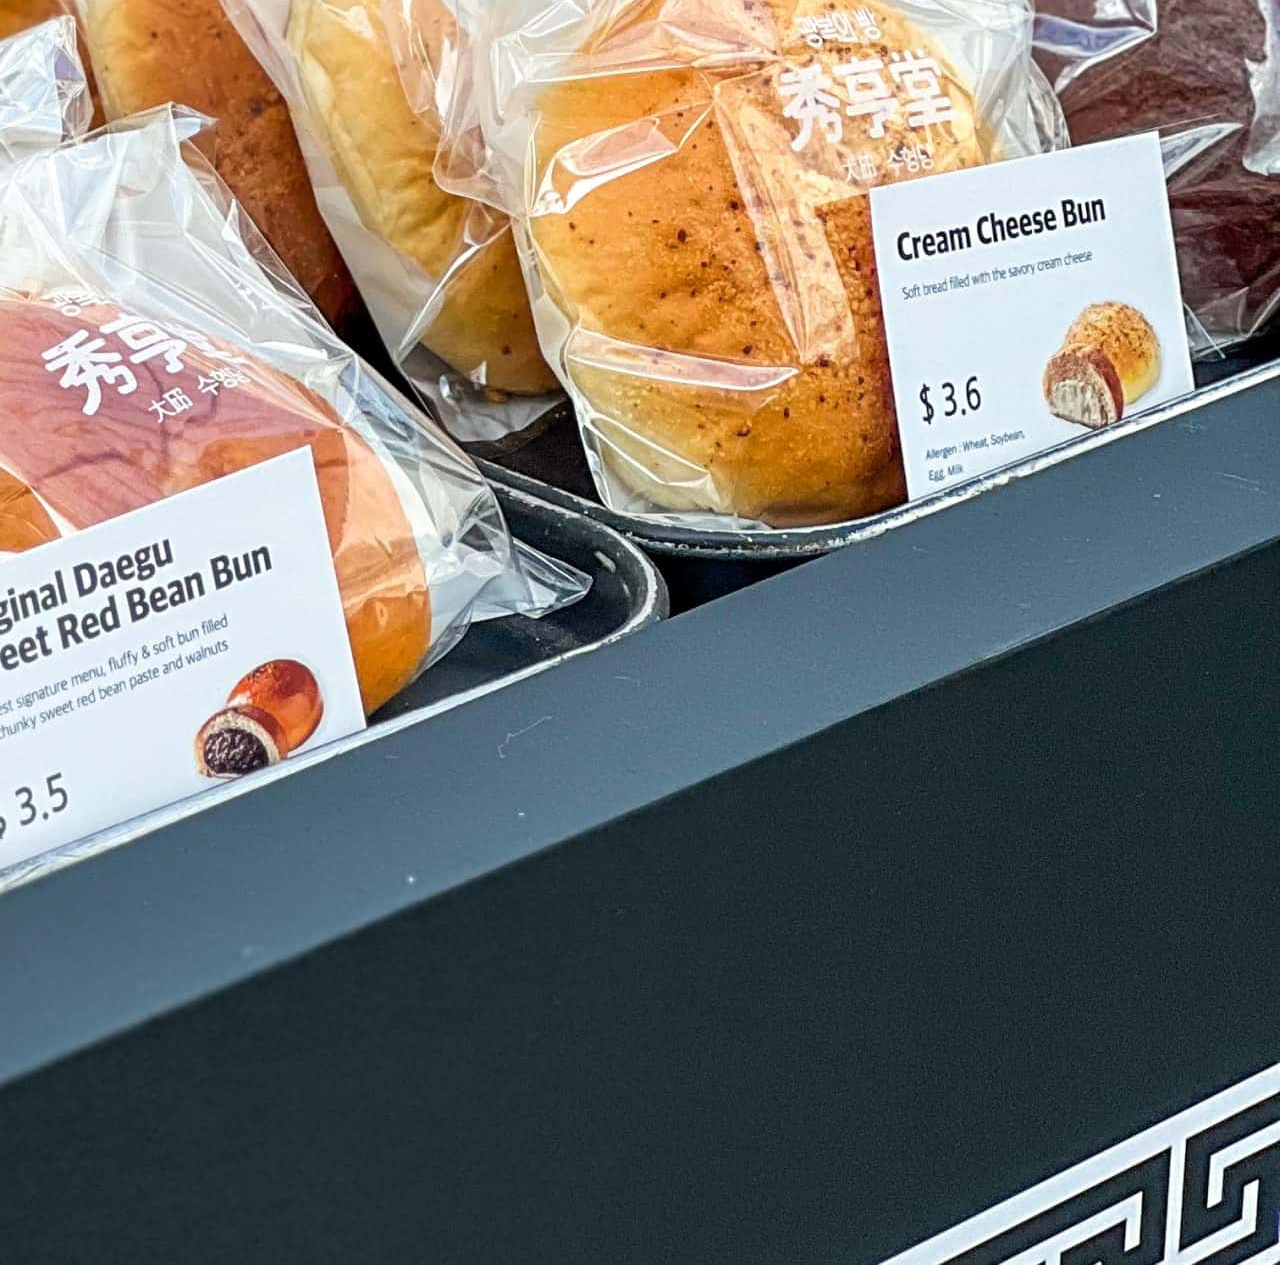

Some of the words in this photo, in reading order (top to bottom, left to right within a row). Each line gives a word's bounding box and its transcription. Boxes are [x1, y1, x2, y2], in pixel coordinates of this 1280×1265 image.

[896, 226, 972, 261] Cream
[976, 209, 1058, 245] Cheese
[1061, 198, 1106, 228] Bun
[901, 283, 921, 301] Soft
[922, 278, 948, 296] bread
[949, 273, 970, 289] filled
[971, 270, 991, 286] with
[991, 267, 1007, 281] the
[1008, 262, 1035, 278] savory
[1037, 257, 1062, 272] cream
[1064, 251, 1093, 266] cheese
[919, 383, 935, 425] $
[941, 375, 982, 417] 3.6
[56, 594, 122, 650] Red
[125, 572, 206, 624] Bean
[209, 546, 273, 591] Bun
[72, 539, 174, 598] Daegu
[15, 678, 69, 709] signature
[70, 665, 107, 688] menu,
[107, 650, 139, 672] fluffy
[140, 644, 152, 660] &
[152, 635, 176, 656] soft
[176, 627, 200, 646] bun
[201, 612, 229, 636] filled
[39, 699, 75, 724] sweet
[76, 688, 97, 709] red
[97, 679, 128, 701] bean
[128, 666, 161, 691] paste
[162, 654, 184, 675] and
[185, 639, 230, 665] walnuts
[14, 771, 69, 827] 3.5
